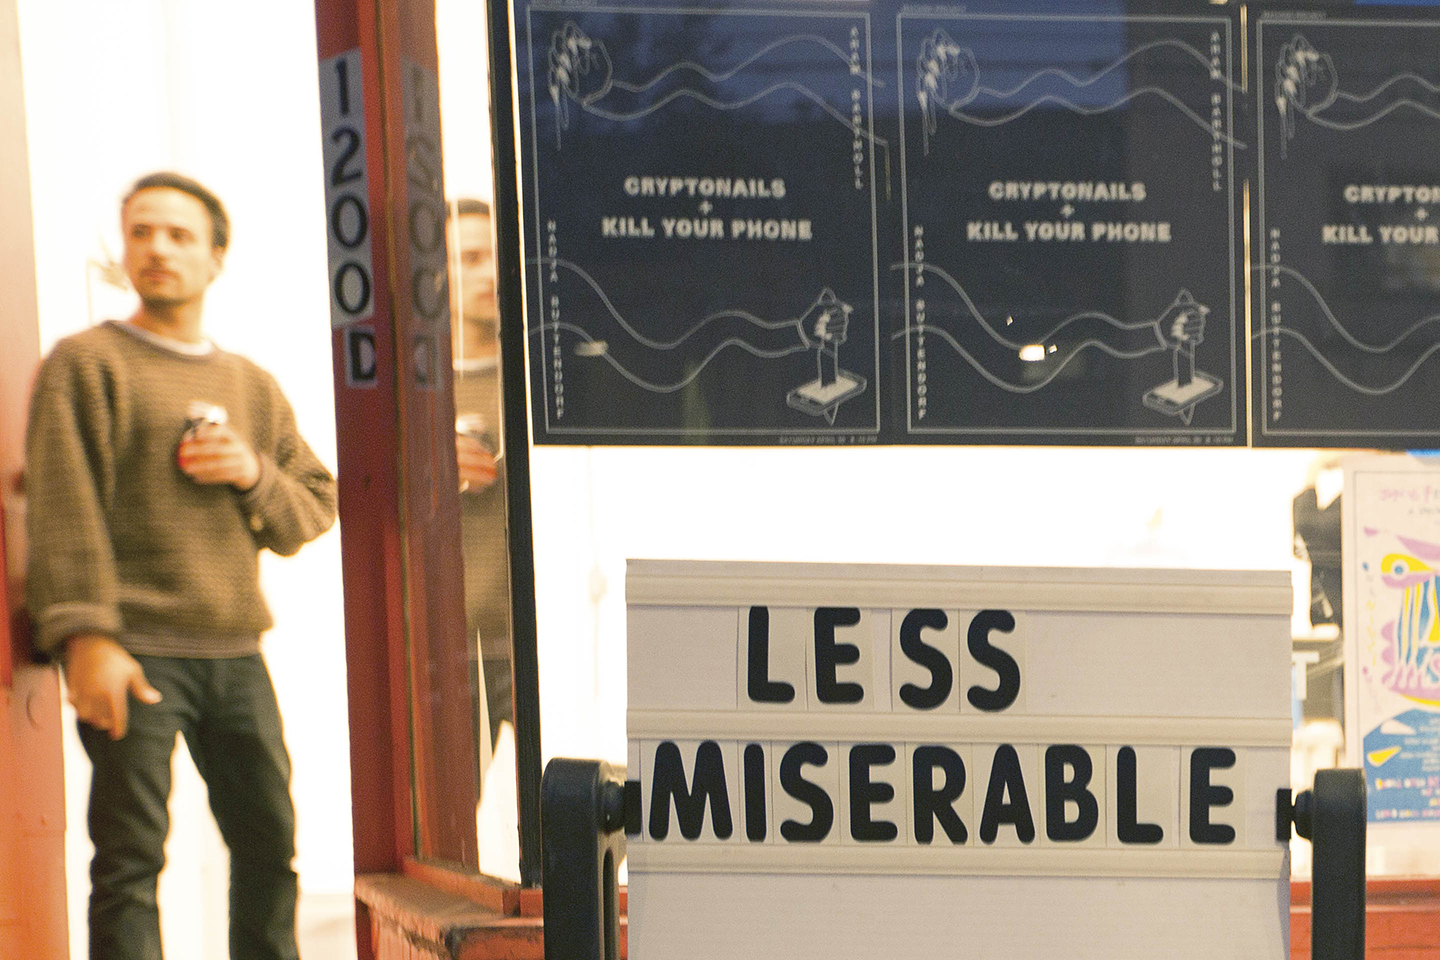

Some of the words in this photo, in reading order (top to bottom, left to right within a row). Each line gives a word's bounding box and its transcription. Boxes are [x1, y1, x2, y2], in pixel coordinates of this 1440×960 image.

[624, 176, 786, 198] CRYPTONAILS
[989, 182, 1147, 202] CRYPTONAILS
[602, 217, 655, 238] KILL
[662, 219, 724, 239] YOUR
[732, 220, 812, 240] PHONE
[967, 222, 1019, 241] KILL
[1024, 222, 1085, 241] YOUR
[1092, 222, 1171, 242] PHONE
[1322, 226, 1373, 244] KILL
[1379, 226, 1438, 244] YOUR
[747, 605, 1021, 713] LESS
[648, 740, 1236, 845] MISERABLE
